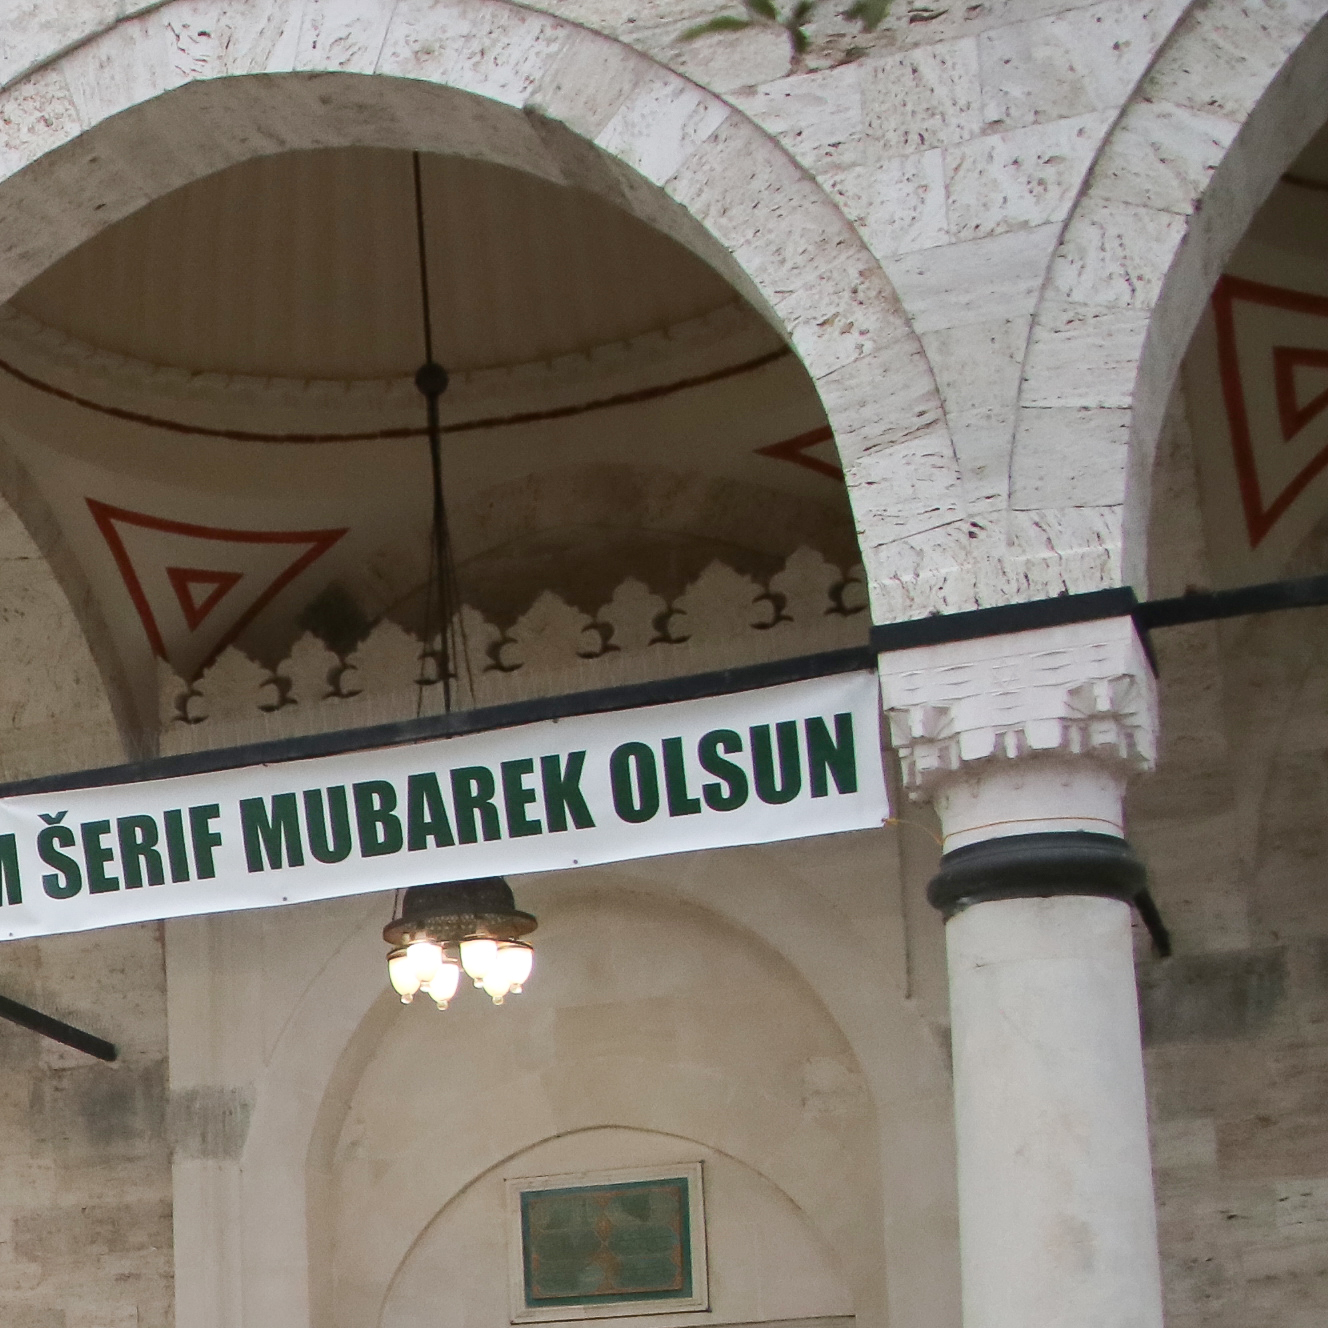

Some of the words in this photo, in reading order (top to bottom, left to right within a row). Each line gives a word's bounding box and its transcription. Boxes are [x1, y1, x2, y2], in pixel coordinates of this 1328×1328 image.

[37, 803, 222, 899] ŠERIF
[239, 750, 597, 873] MUBAREK
[609, 712, 858, 824] OLSUN
